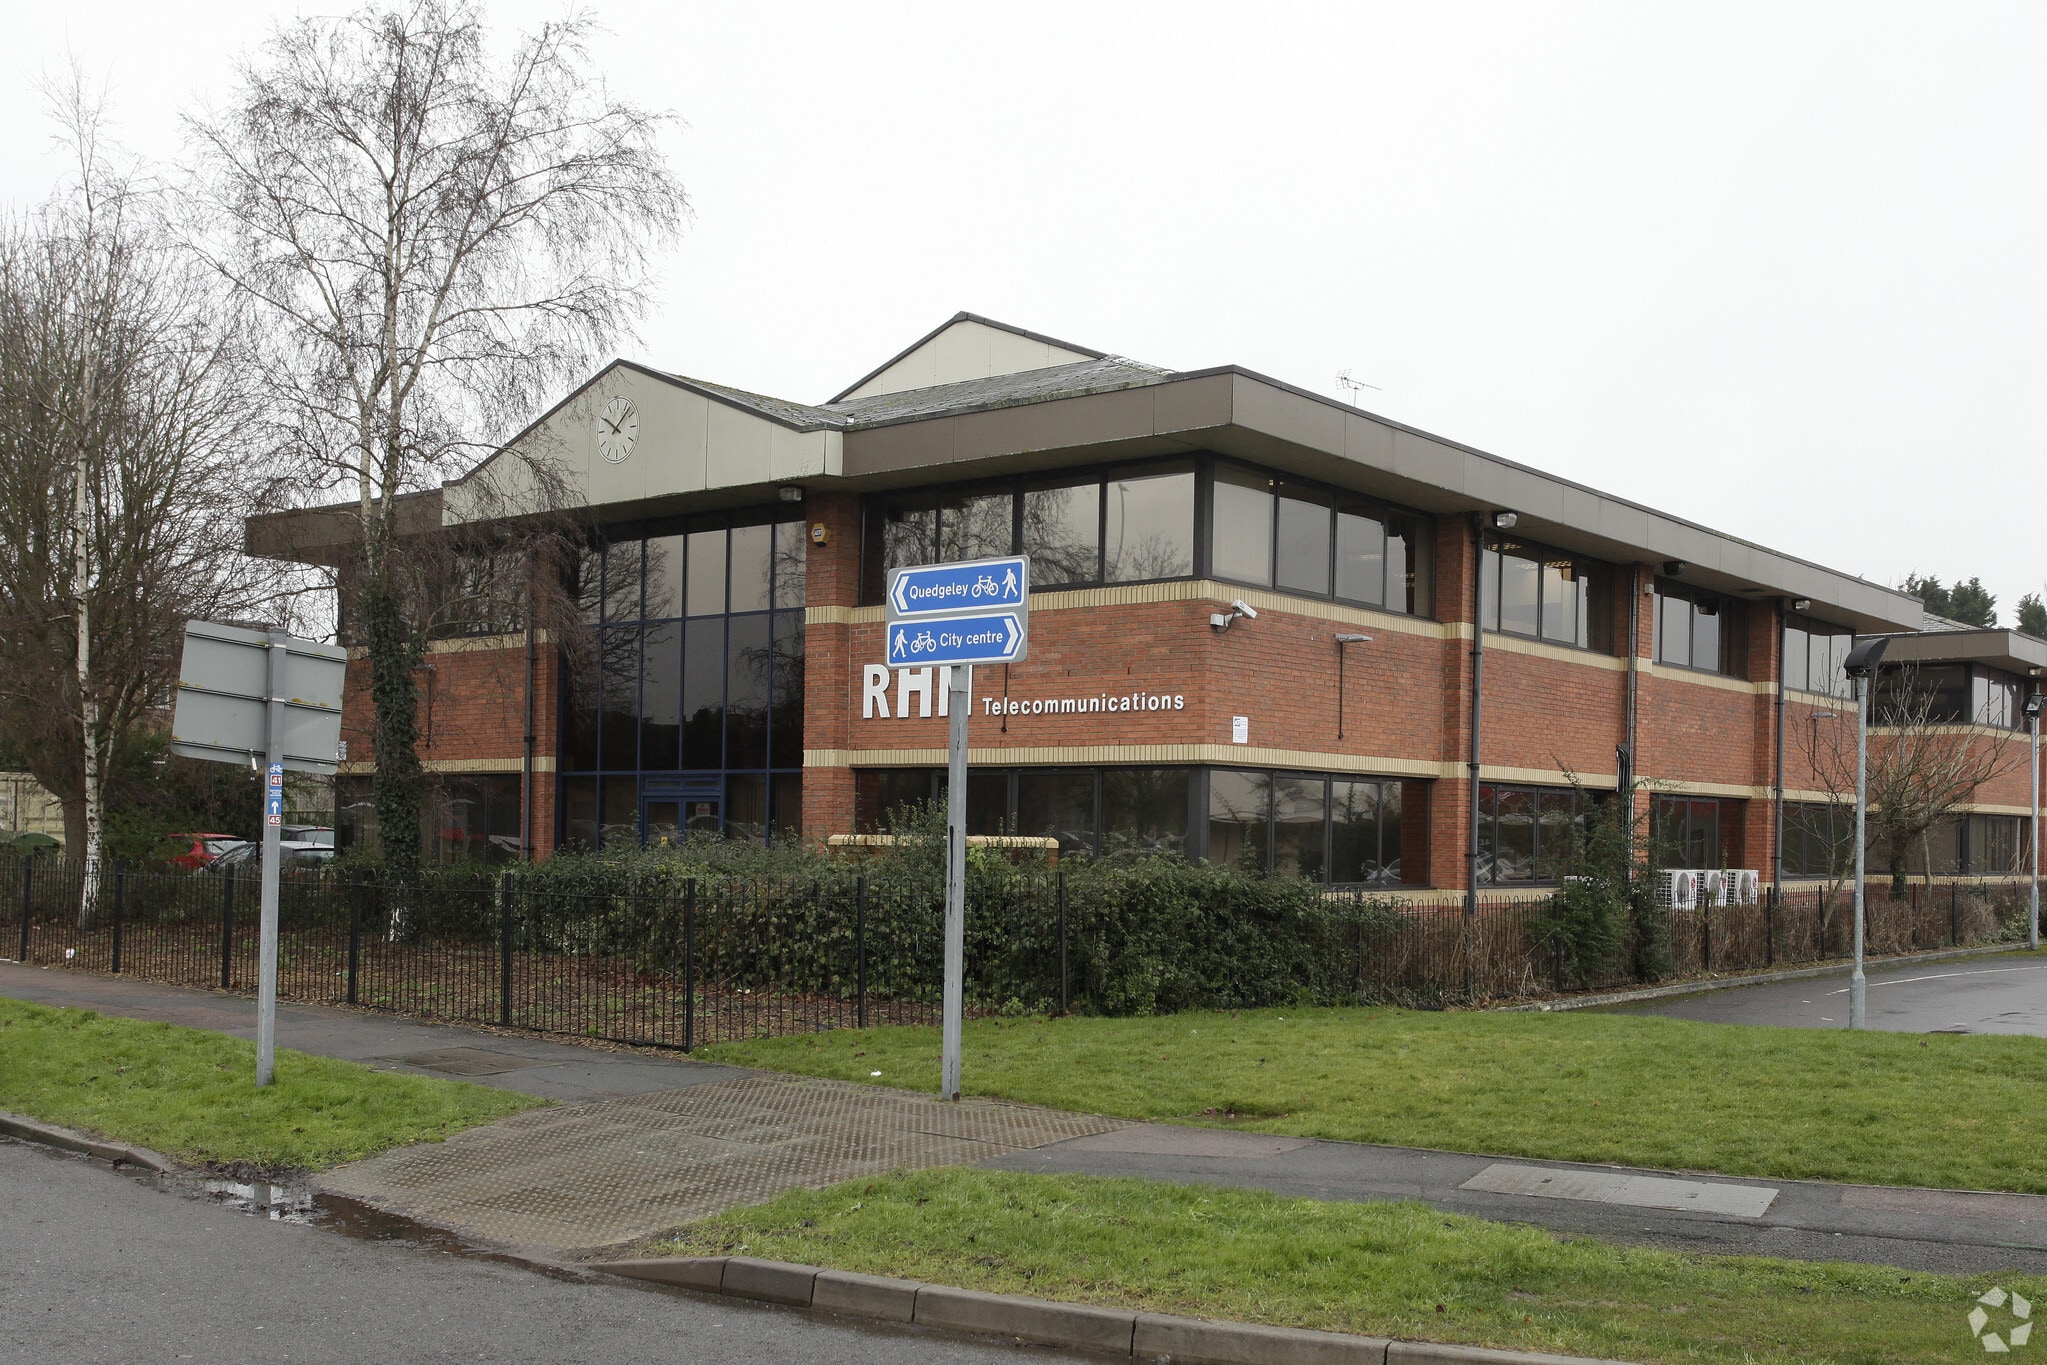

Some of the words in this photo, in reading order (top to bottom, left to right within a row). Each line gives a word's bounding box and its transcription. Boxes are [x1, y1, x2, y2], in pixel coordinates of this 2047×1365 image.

[910, 582, 969, 600] Quedgeley
[940, 632, 963, 648] City
[966, 630, 1003, 645] centre
[982, 691, 1185, 715] Telecommunications
